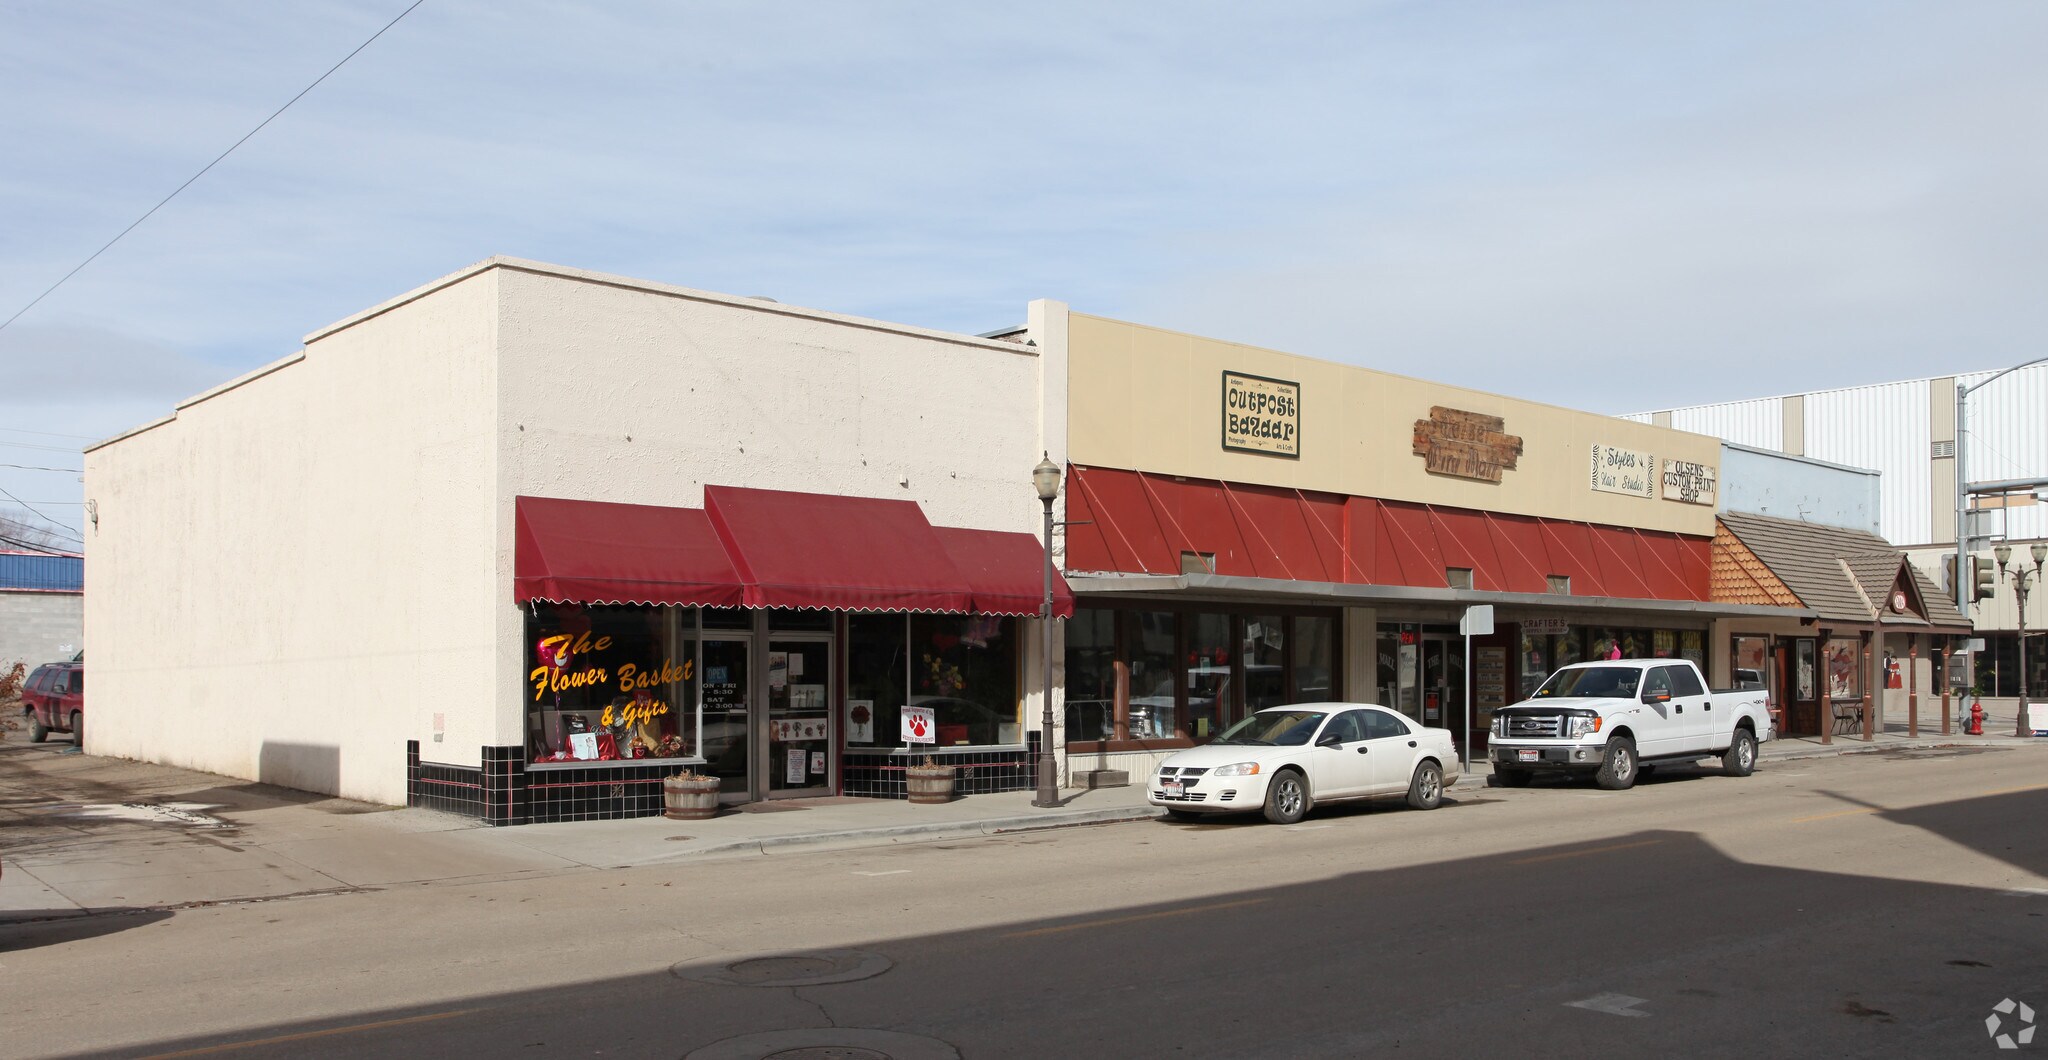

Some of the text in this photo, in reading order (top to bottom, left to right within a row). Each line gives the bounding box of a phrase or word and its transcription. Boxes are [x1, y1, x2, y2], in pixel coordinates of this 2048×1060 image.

[1228, 388, 1295, 417] Outpost
[1228, 413, 1294, 441] Bazaar
[1607, 448, 1636, 470] Styles
[1675, 461, 1704, 477] OLSENS
[1600, 472, 1644, 492] Hair Studio
[1663, 472, 1716, 493] CUSTOM PRINT
[1680, 489, 1700, 503] SHOP
[1523, 617, 1566, 629] CRAFTER'S
[543, 630, 613, 660] The
[1427, 654, 1440, 669] THE
[530, 666, 608, 701] Flower
[617, 658, 693, 692] Basket
[707, 668, 727, 680] OPEN
[600, 705, 614, 726] &
[622, 699, 668, 729] Gifts
